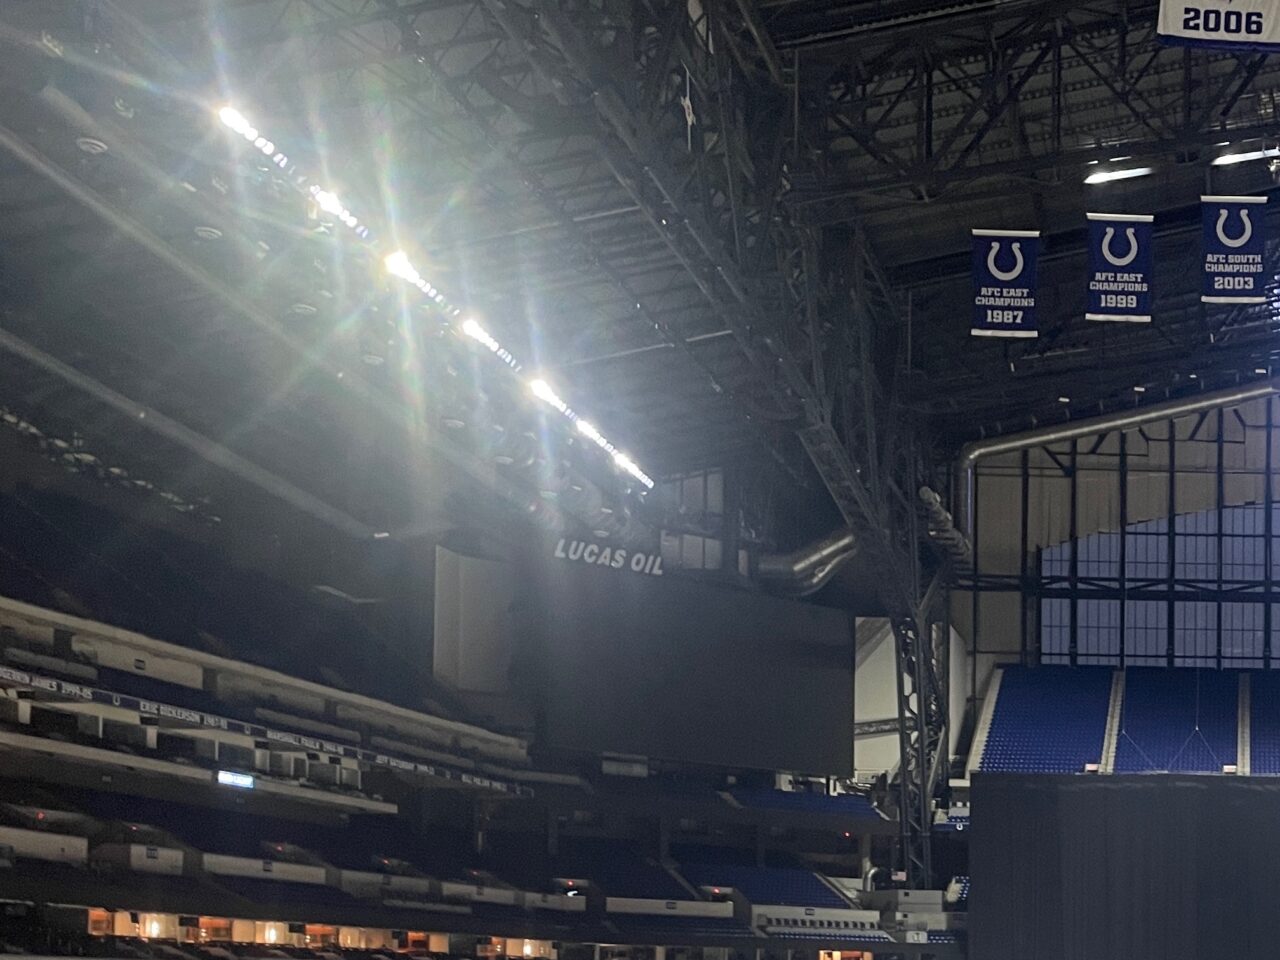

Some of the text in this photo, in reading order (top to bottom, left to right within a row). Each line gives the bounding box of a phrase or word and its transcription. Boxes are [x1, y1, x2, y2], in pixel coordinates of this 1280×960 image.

[1183, 7, 1263, 34] 2006
[1206, 254, 1262, 263] AFC SOUTH
[1205, 263, 1263, 273] CHAMPIONS
[1095, 272, 1143, 282] AFC EAST
[1090, 281, 1148, 291] CHAMPIONS
[1214, 276, 1254, 289] 2003
[981, 287, 1029, 297] AFC EAST
[975, 297, 1035, 307] CHAMPIONS
[1101, 294, 1137, 307] 1999
[986, 310, 1023, 323] 1987
[554, 538, 663, 575] LUCAS OIL
